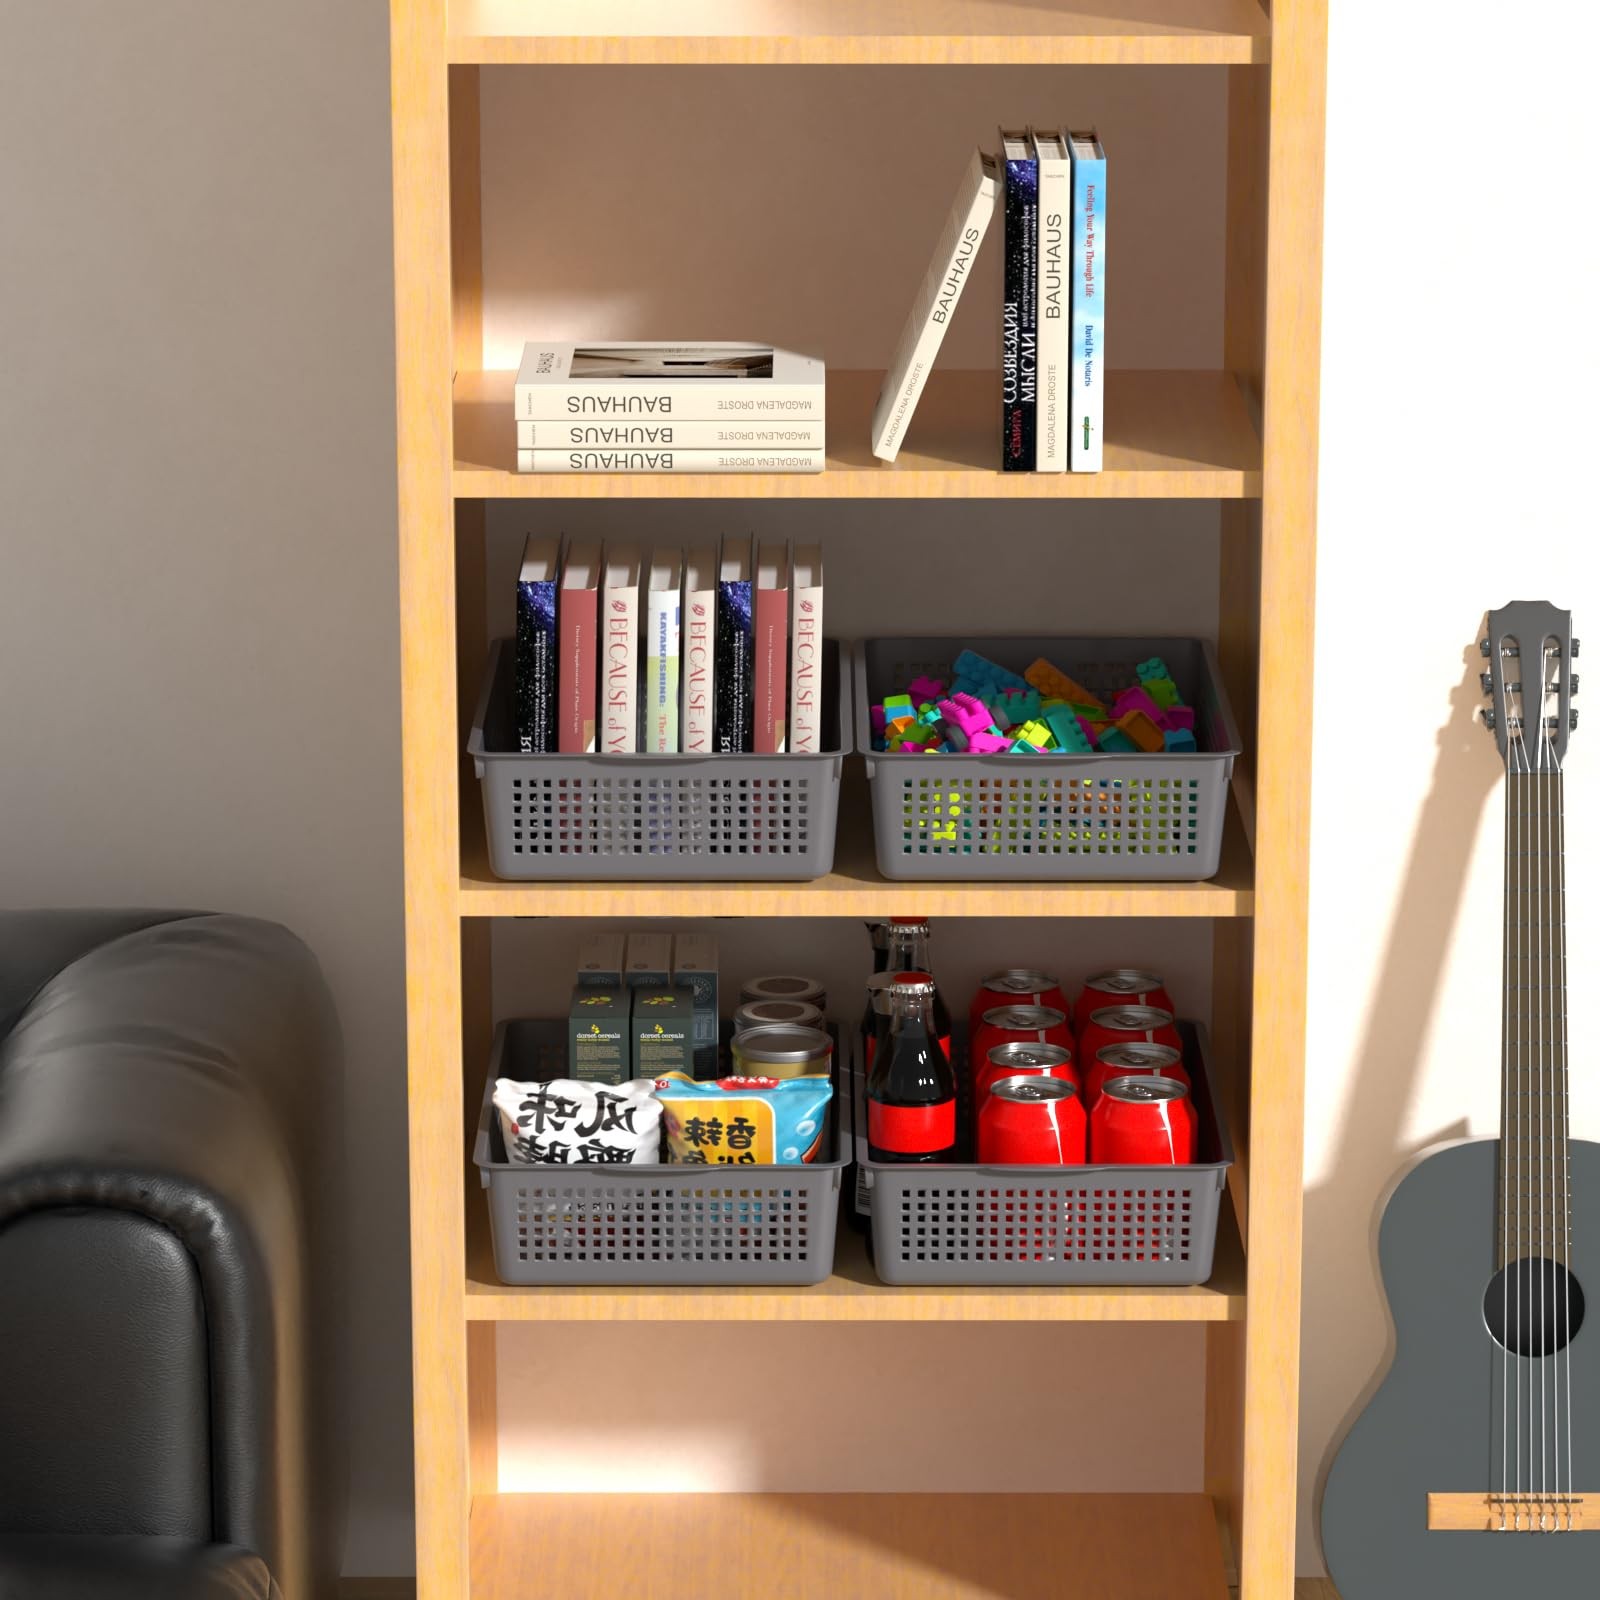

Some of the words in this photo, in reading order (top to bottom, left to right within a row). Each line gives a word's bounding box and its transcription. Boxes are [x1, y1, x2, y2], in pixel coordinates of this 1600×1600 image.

[1086, 185, 1095, 212] Feeling
[1086, 214, 1095, 231] Your
[1084, 233, 1095, 248] Way
[1046, 213, 1062, 319] BAUHAUS
[1084, 251, 1094, 281] Through
[932, 228, 979, 324] BAUHAUS
[1085, 284, 1094, 298] Life
[1085, 325, 1094, 346] David
[1003, 302, 1019, 404] СОЗВЕЗДИЯ
[1085, 348, 1093, 358] De
[1021, 333, 1036, 402] МЫСЛИ
[1084, 360, 1093, 387] Notaris
[1047, 364, 1056, 400] DROSTE
[567, 396, 672, 413] BAUHAUS
[717, 400, 754, 410] DROSTE
[755, 400, 812, 410] MAGDALENA
[885, 397, 909, 447] MAGDALENA
[906, 363, 924, 396] DROSTE
[570, 427, 673, 443] BAUHAUS
[717, 431, 753, 440] DROSTE
[755, 431, 811, 440] MAGDALENA
[1047, 404, 1056, 458] MAGDALENA
[570, 453, 673, 469] BAUHAUS
[717, 457, 754, 466] DROSTE
[755, 457, 812, 466] MAGDALENA
[609, 618, 629, 713] BECAUSE
[658, 612, 667, 707] KAYAKFISHING:
[797, 618, 814, 713] BECAUSE
[690, 622, 706, 717] BECAUSE
[608, 718, 626, 733] of
[658, 714, 667, 736] The
[689, 722, 703, 735] of
[796, 718, 811, 733] of
